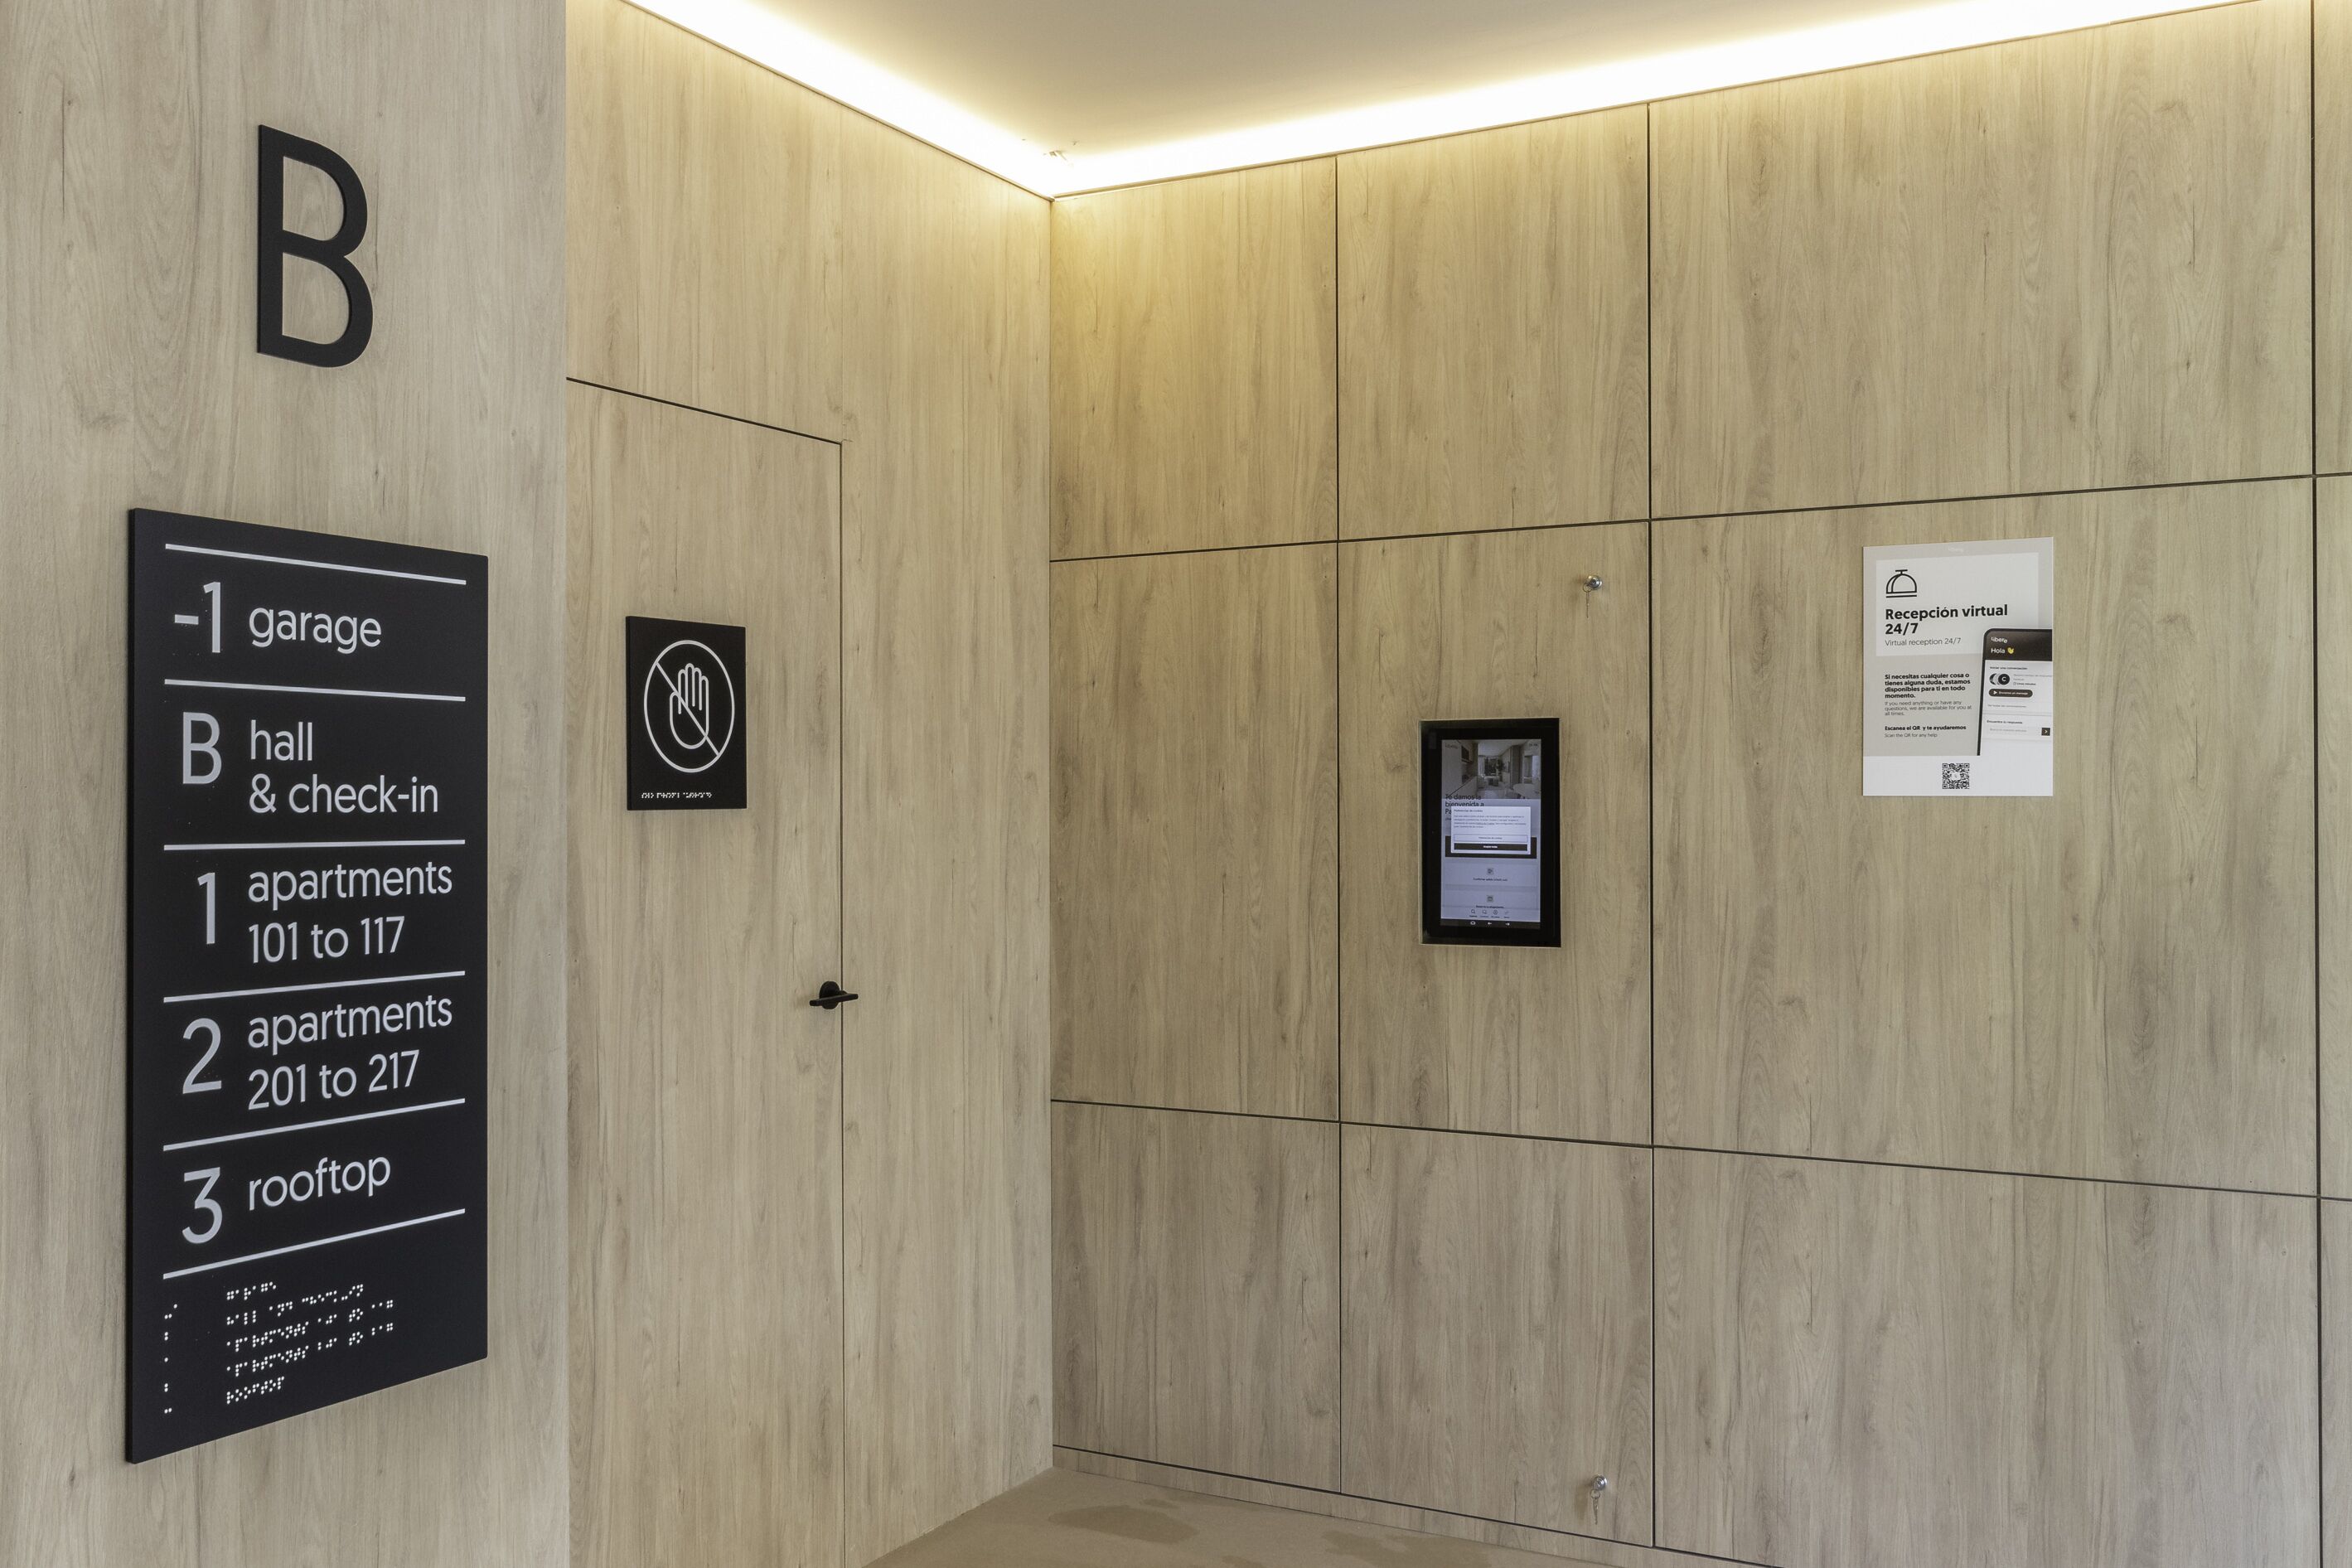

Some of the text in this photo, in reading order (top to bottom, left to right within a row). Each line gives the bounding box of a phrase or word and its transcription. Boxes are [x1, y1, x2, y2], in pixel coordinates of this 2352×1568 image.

[257, 124, 373, 368] B
[174, 581, 382, 654] -1 garage
[1885, 622, 1918, 635] 24/7
[1886, 604, 2008, 621] Recepción virtual
[1909, 638, 1942, 646] reception
[182, 711, 223, 785] B
[250, 720, 313, 761] hall
[249, 773, 439, 814] & check-in
[196, 872, 216, 945] 1
[249, 861, 452, 911] apartments
[249, 916, 406, 963] 101 to 117
[249, 995, 452, 1055] apartments
[182, 1018, 223, 1094] 2
[248, 1049, 420, 1110] 201 to 217
[181, 1156, 391, 1244] 3 rooftop
